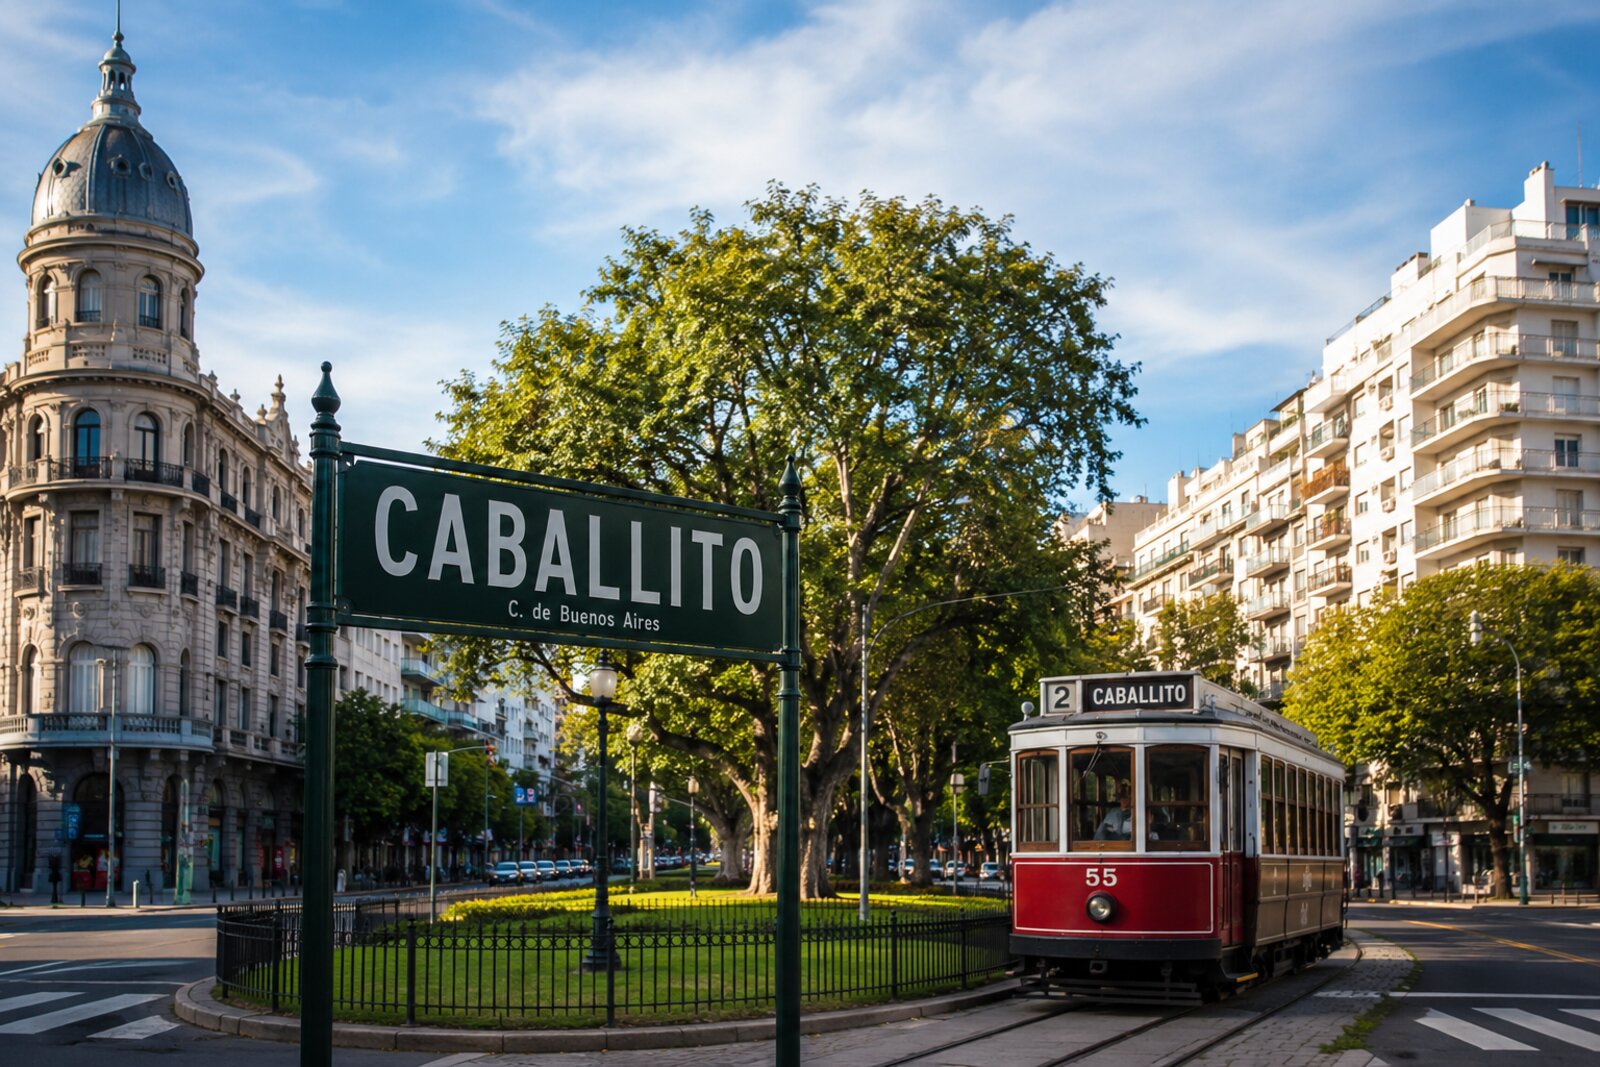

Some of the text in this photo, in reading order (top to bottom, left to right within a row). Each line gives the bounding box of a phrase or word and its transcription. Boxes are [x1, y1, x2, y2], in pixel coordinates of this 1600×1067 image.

[374, 485, 764, 615] CABALLITO
[508, 600, 660, 632] C. de Buenos Aires
[1054, 684, 1187, 709] 2 CABALLITO
[1086, 867, 1118, 887] 55
